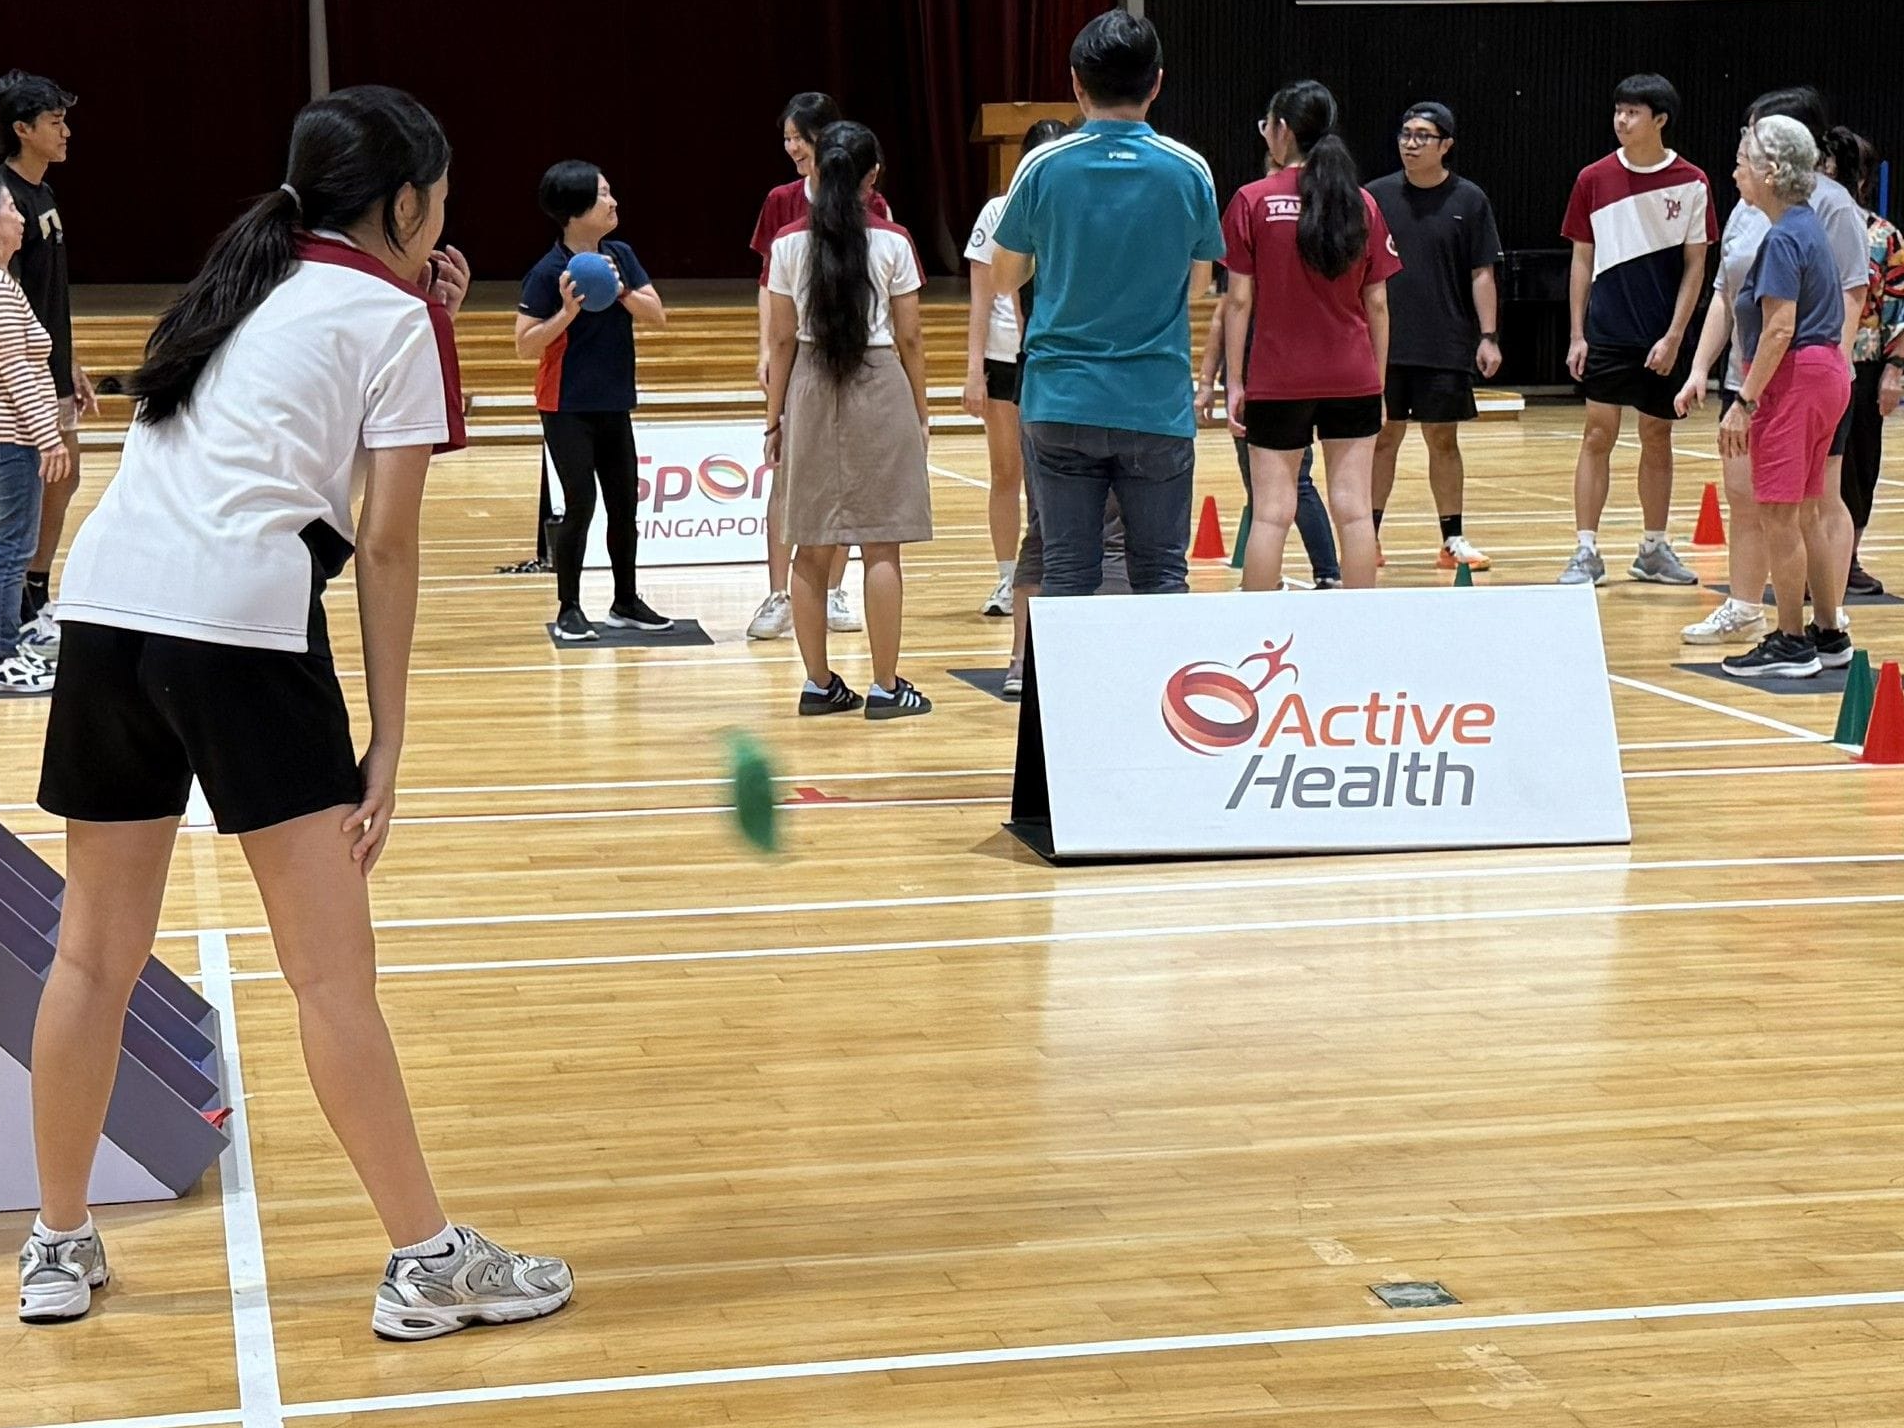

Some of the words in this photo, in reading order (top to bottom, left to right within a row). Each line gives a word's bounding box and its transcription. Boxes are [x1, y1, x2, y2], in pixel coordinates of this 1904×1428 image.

[637, 453, 776, 513] Spor
[636, 516, 769, 539] INGAPO
[1258, 691, 1496, 748] Active
[1225, 751, 1475, 810] Health
